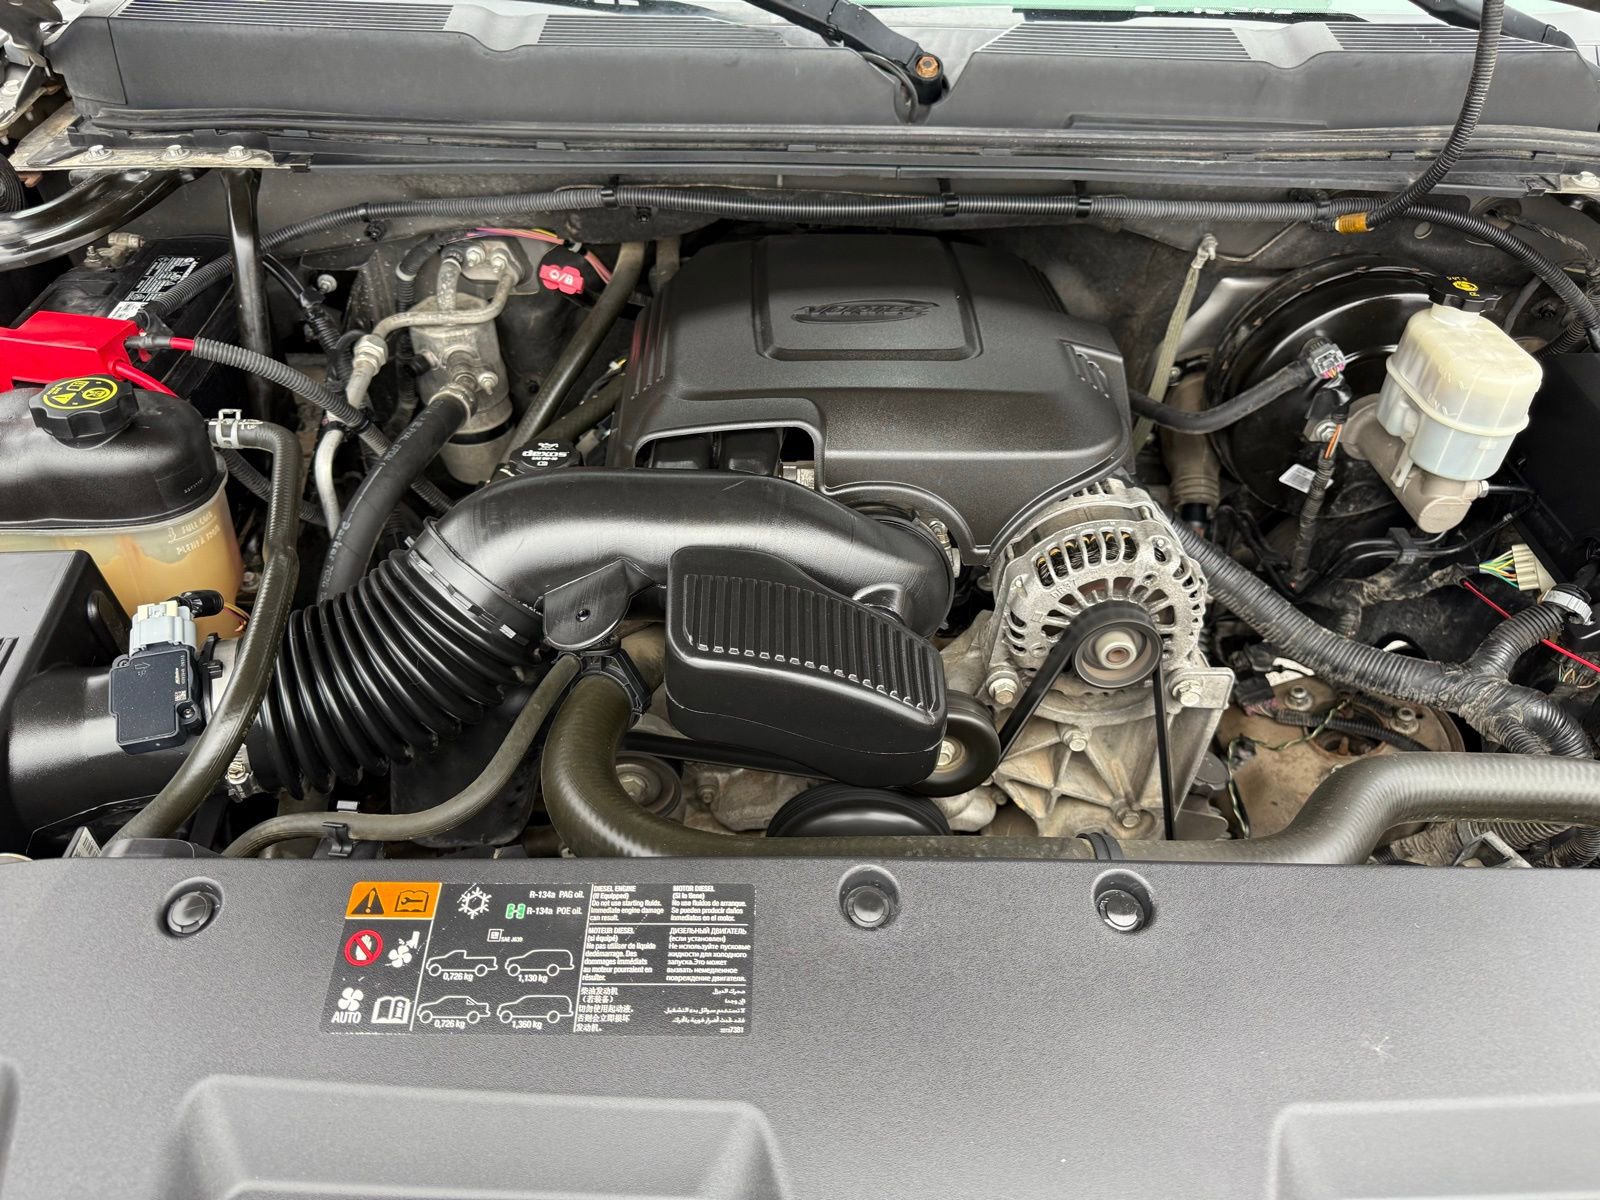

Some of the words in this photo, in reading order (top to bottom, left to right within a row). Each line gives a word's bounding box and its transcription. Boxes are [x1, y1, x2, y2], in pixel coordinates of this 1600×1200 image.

[669, 927, 710, 935] ДИЗЕЛЬНЫЙ
[443, 972, 462, 981] 0,726
[464, 973, 474, 982] kg
[518, 974, 537, 983] 1,130
[538, 974, 548, 983] kg
[331, 1011, 361, 1023] AUTO
[434, 1020, 454, 1029] 0,726
[456, 1020, 465, 1029] kg
[532, 1021, 542, 1030] kg
